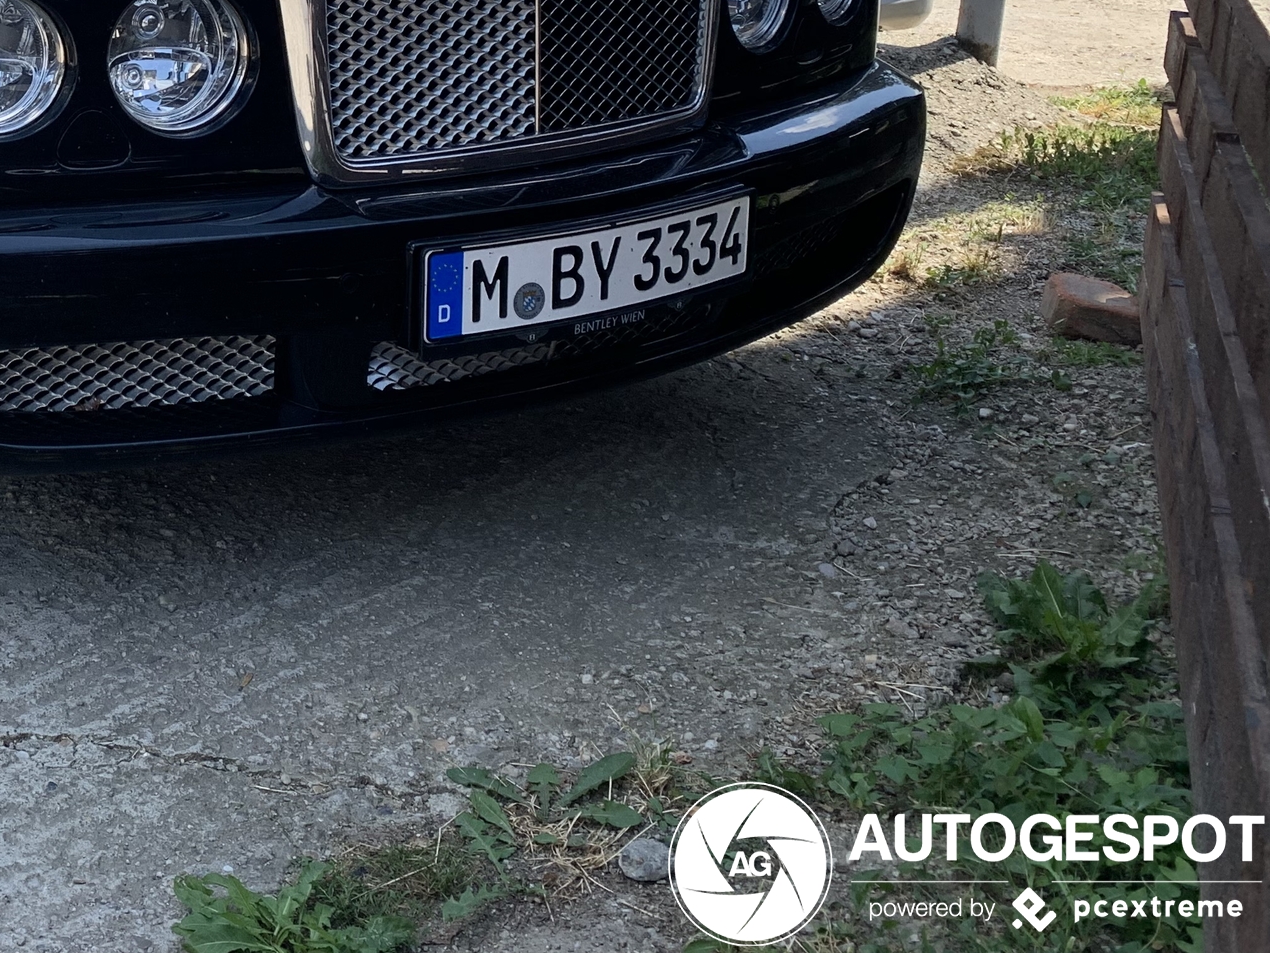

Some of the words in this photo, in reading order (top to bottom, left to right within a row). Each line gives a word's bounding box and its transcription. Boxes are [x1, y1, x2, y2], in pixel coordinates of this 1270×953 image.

[471, 255, 509, 323] M
[551, 235, 622, 310] BY
[633, 205, 742, 291] 3334
[438, 304, 451, 323] D
[574, 316, 619, 335] BENTLEY
[620, 309, 646, 325] WIEN
